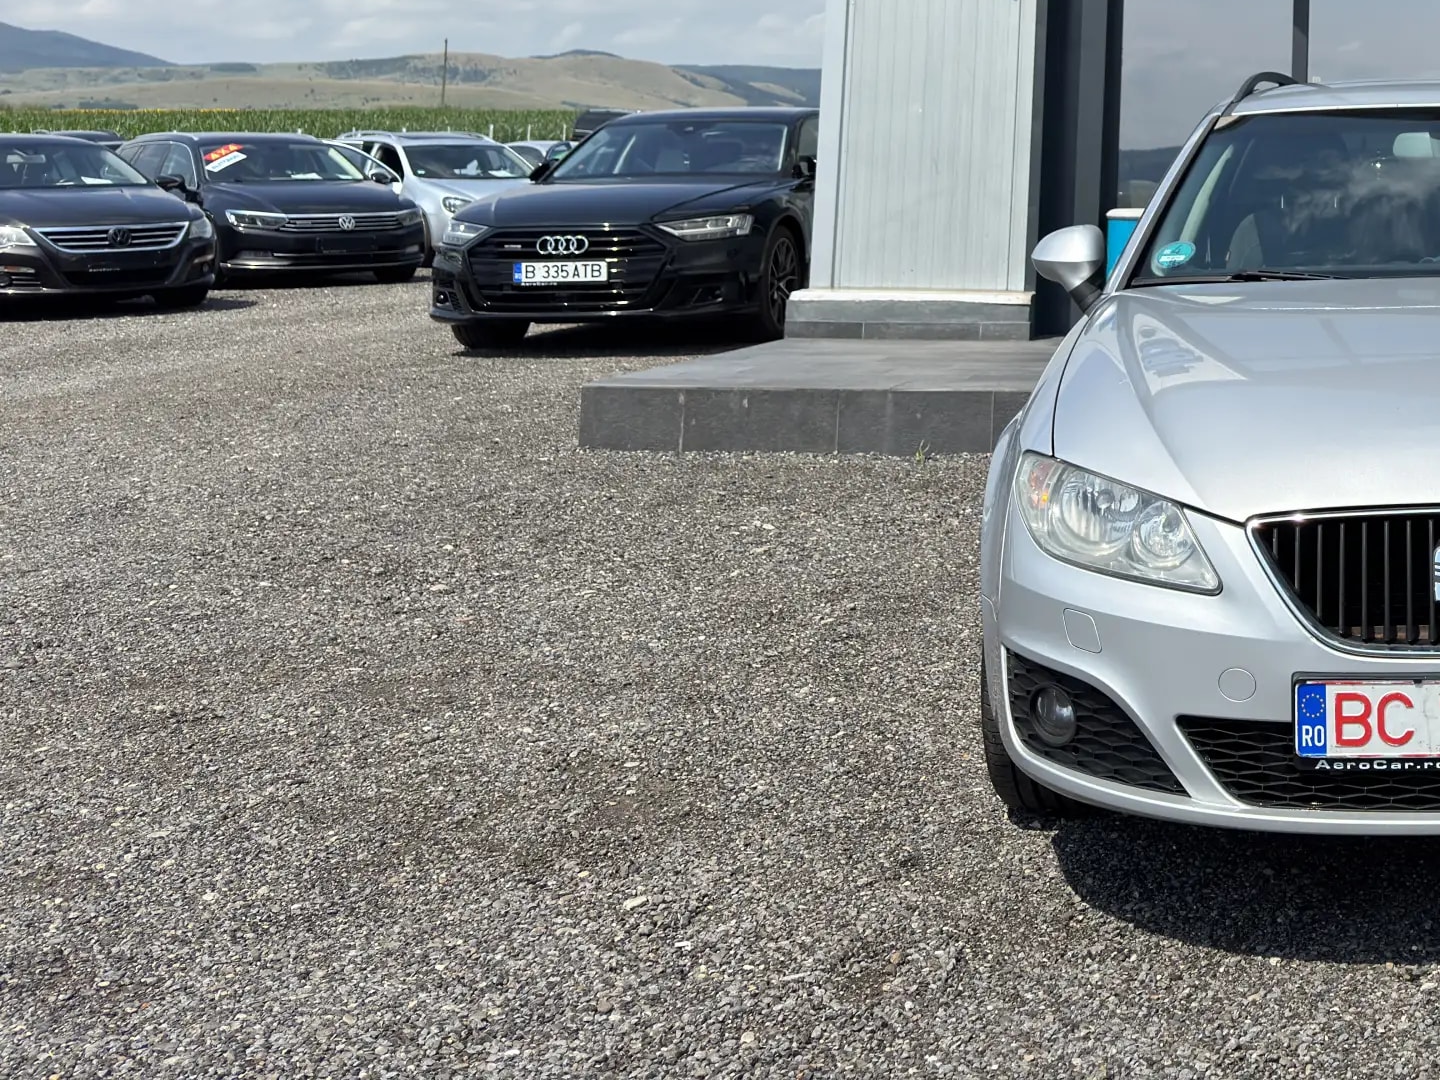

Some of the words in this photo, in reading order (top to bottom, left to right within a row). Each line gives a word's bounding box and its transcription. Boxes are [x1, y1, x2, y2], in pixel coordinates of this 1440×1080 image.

[525, 264, 536, 279] B
[542, 264, 569, 279] 335
[572, 263, 602, 278] ATB
[1335, 691, 1415, 747] BC
[1302, 725, 1325, 747] RO
